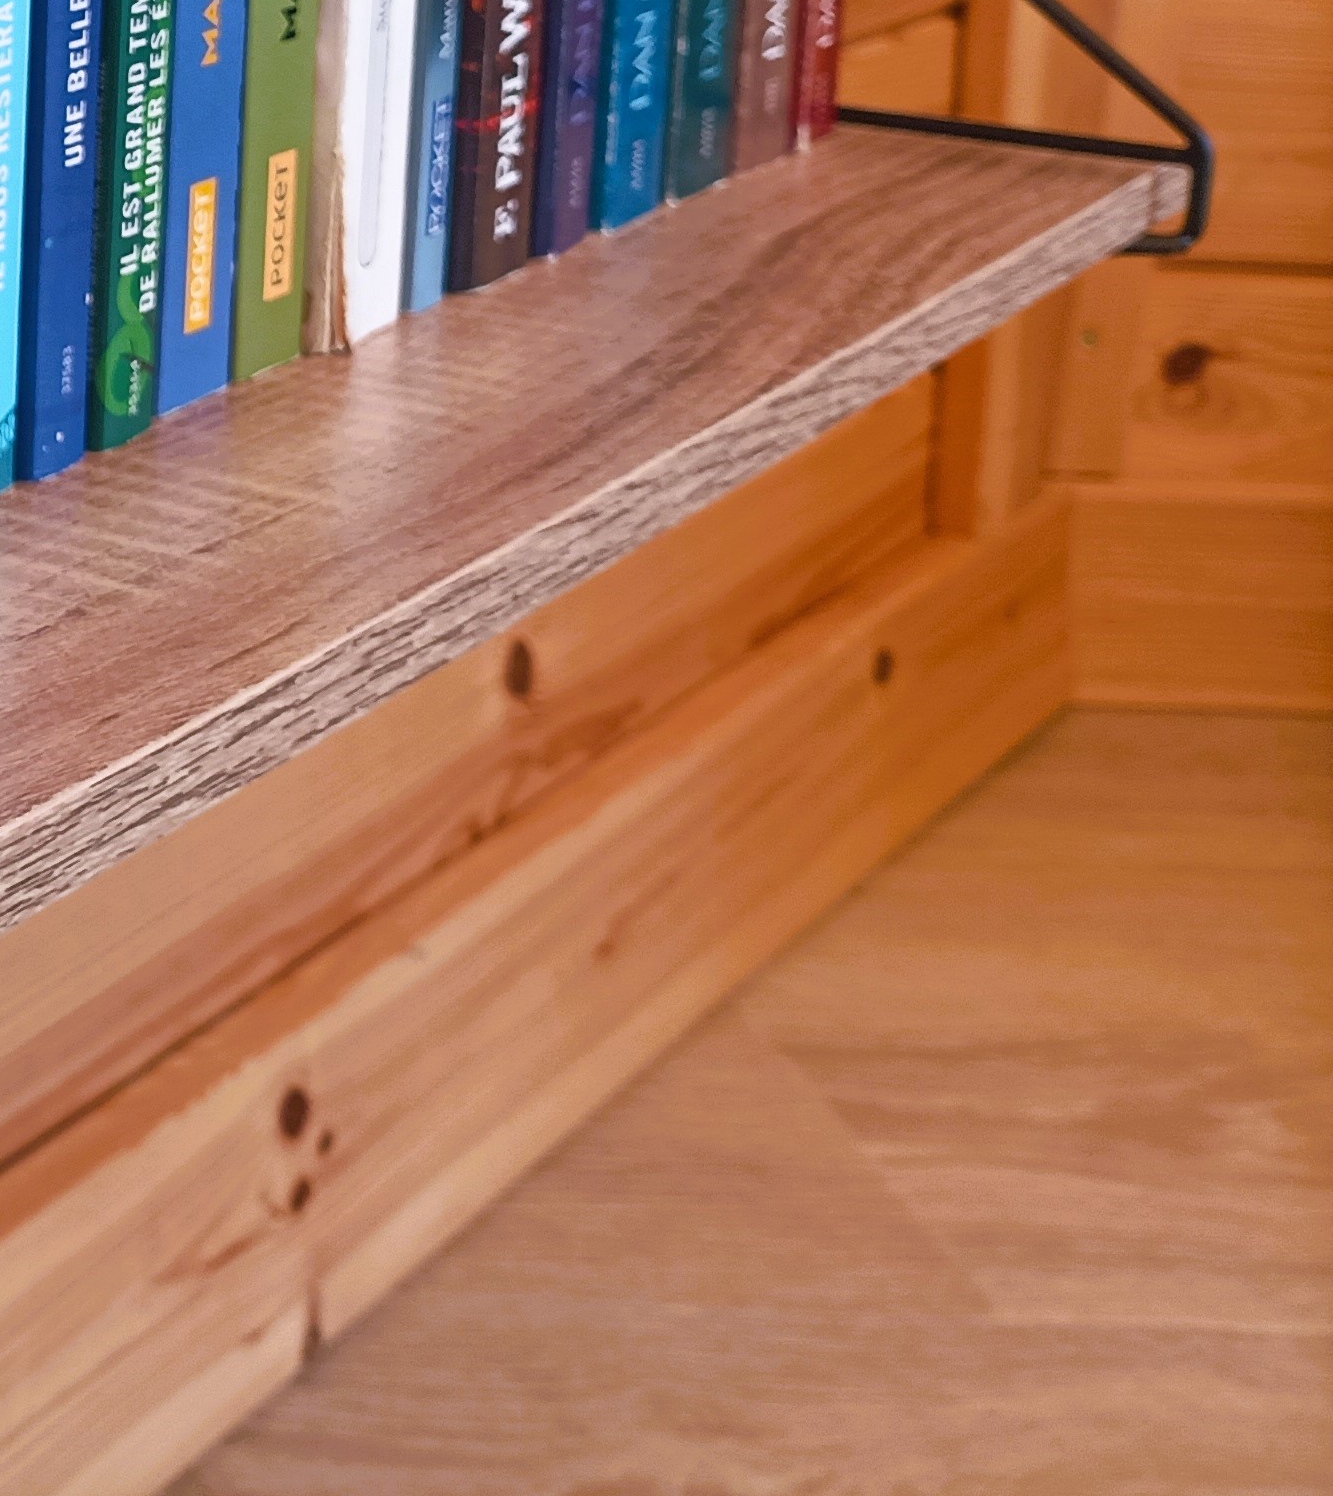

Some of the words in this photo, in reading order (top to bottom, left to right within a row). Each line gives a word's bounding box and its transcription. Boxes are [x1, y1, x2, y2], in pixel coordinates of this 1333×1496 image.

[148, 28, 169, 89] LES
[64, 100, 85, 168] UNE
[124, 59, 149, 172] GRAND
[494, 53, 529, 192] PAUL
[142, 93, 165, 261] RALLUMER
[122, 182, 142, 238] EST
[120, 245, 140, 275] IL
[139, 265, 157, 313] DE
